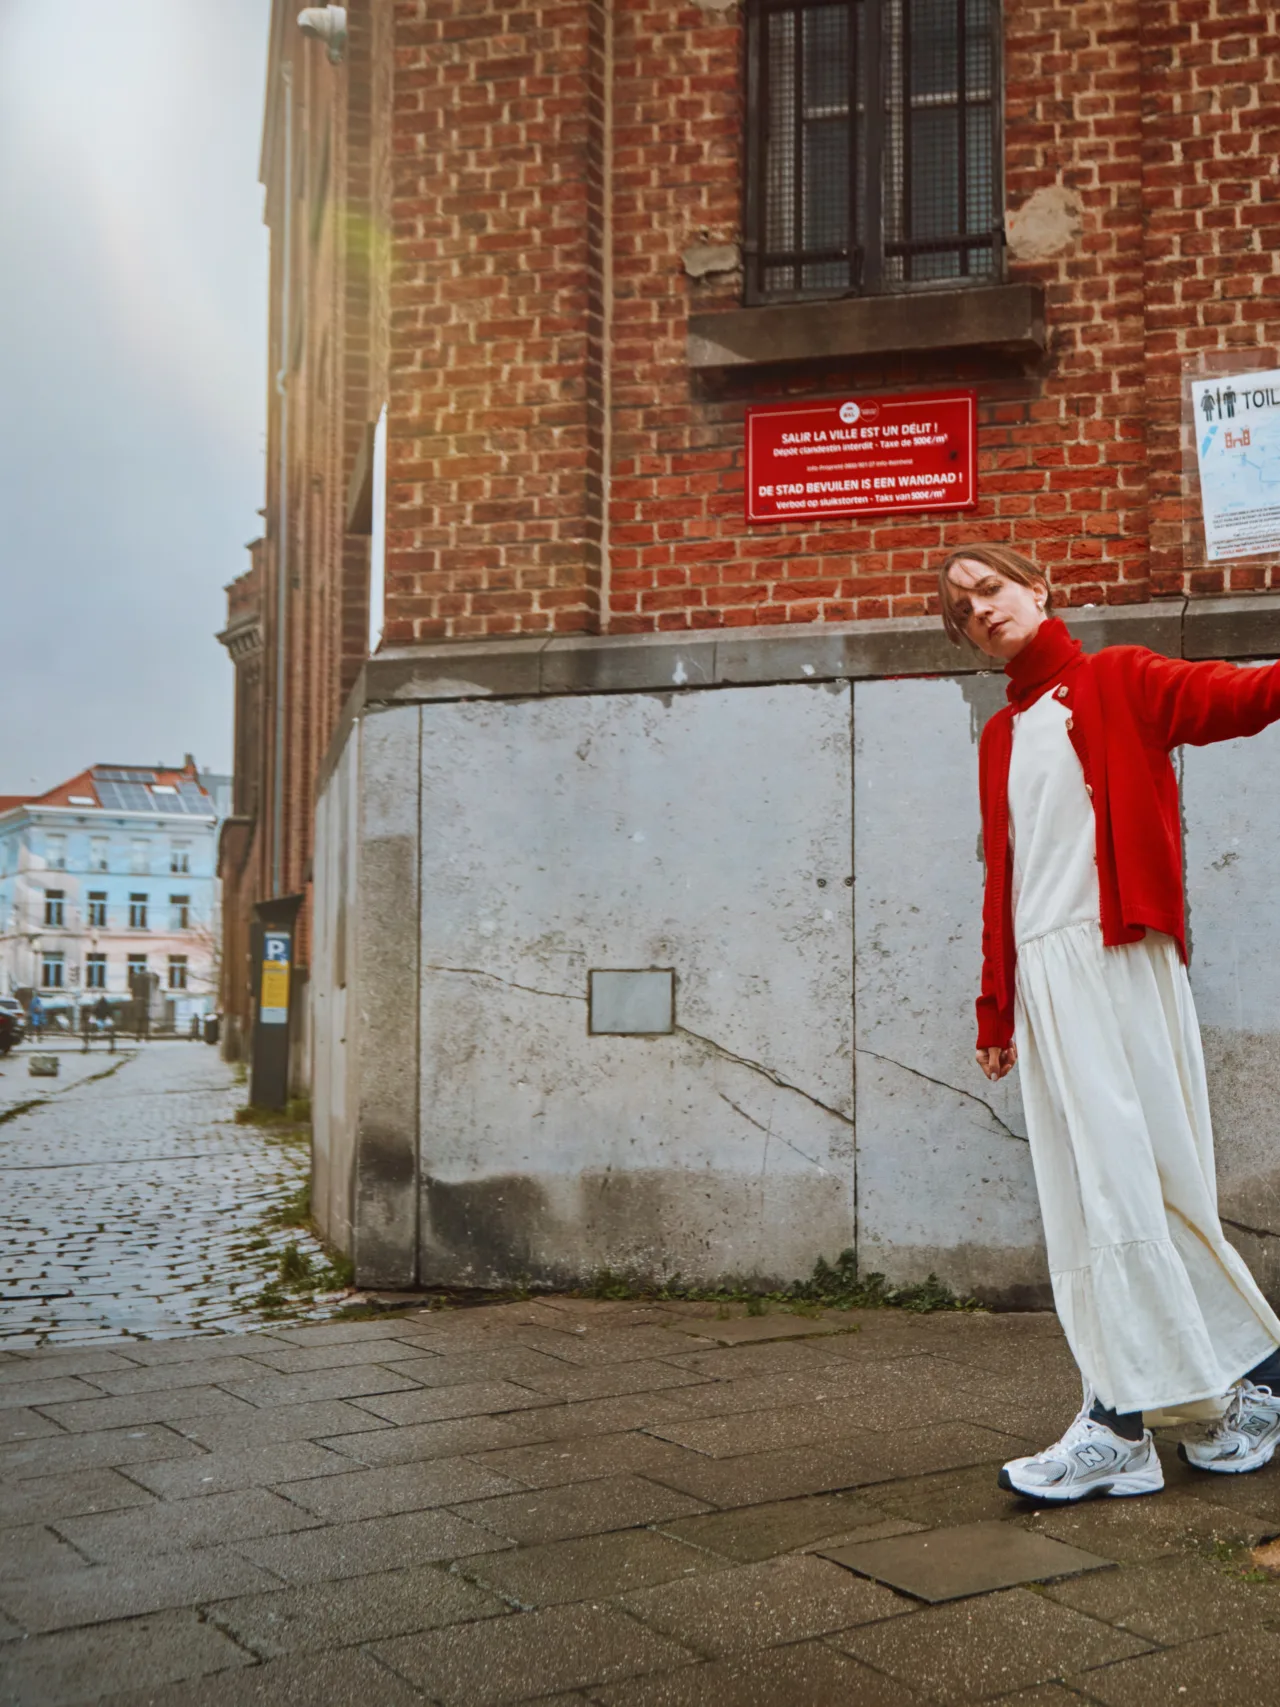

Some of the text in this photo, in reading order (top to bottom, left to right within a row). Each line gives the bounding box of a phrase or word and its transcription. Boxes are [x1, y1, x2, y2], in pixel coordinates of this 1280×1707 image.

[782, 432, 811, 445] SALIR
[814, 431, 827, 442] LA
[829, 428, 856, 441] VILLE
[860, 426, 881, 439] EST
[882, 425, 898, 437] UN
[902, 421, 931, 434] DÉLIT
[799, 445, 842, 456] clandestin
[842, 441, 874, 451] interdit
[880, 439, 899, 450] Taxe
[901, 438, 912, 448] de
[758, 485, 773, 497] DE
[775, 482, 802, 495] STAD
[806, 479, 858, 494] BEVUILEN
[861, 477, 871, 489] IS
[873, 476, 895, 489] EEN
[898, 473, 956, 486] WANDAAD
[807, 498, 819, 509] op
[820, 494, 868, 506] sluikstorten
[875, 494, 893, 503] Taks
[895, 494, 911, 502] van
[267, 939, 285, 960] P
[1076, 1445, 1104, 1467] N
